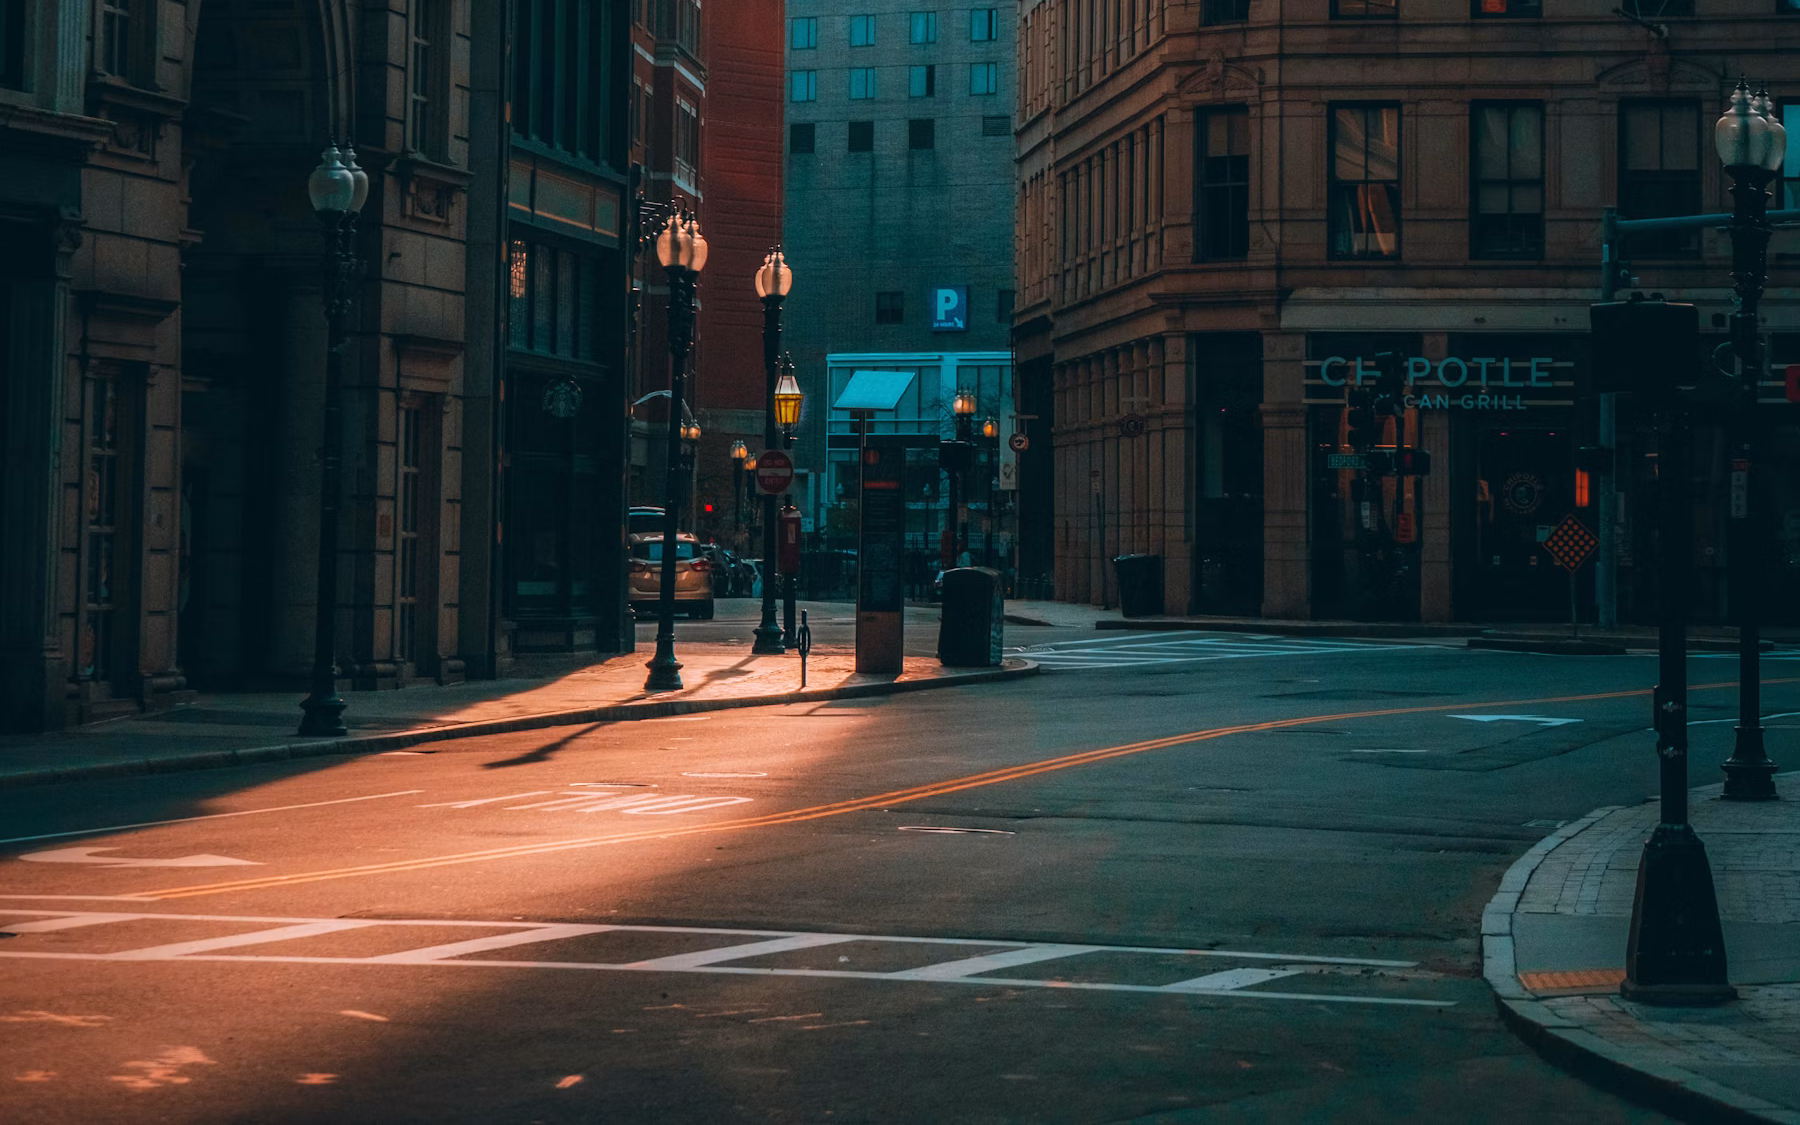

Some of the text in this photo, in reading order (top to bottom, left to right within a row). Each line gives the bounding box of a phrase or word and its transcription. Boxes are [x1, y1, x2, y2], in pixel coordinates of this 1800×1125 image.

[936, 288, 959, 321] P
[1320, 355, 1554, 388] CHPOTLE
[1460, 394, 1529, 411] GRILL
[773, 459, 785, 467] NOT
[1330, 455, 1359, 467] BEDFORD
[1503, 472, 1541, 490] CHIPOTL
